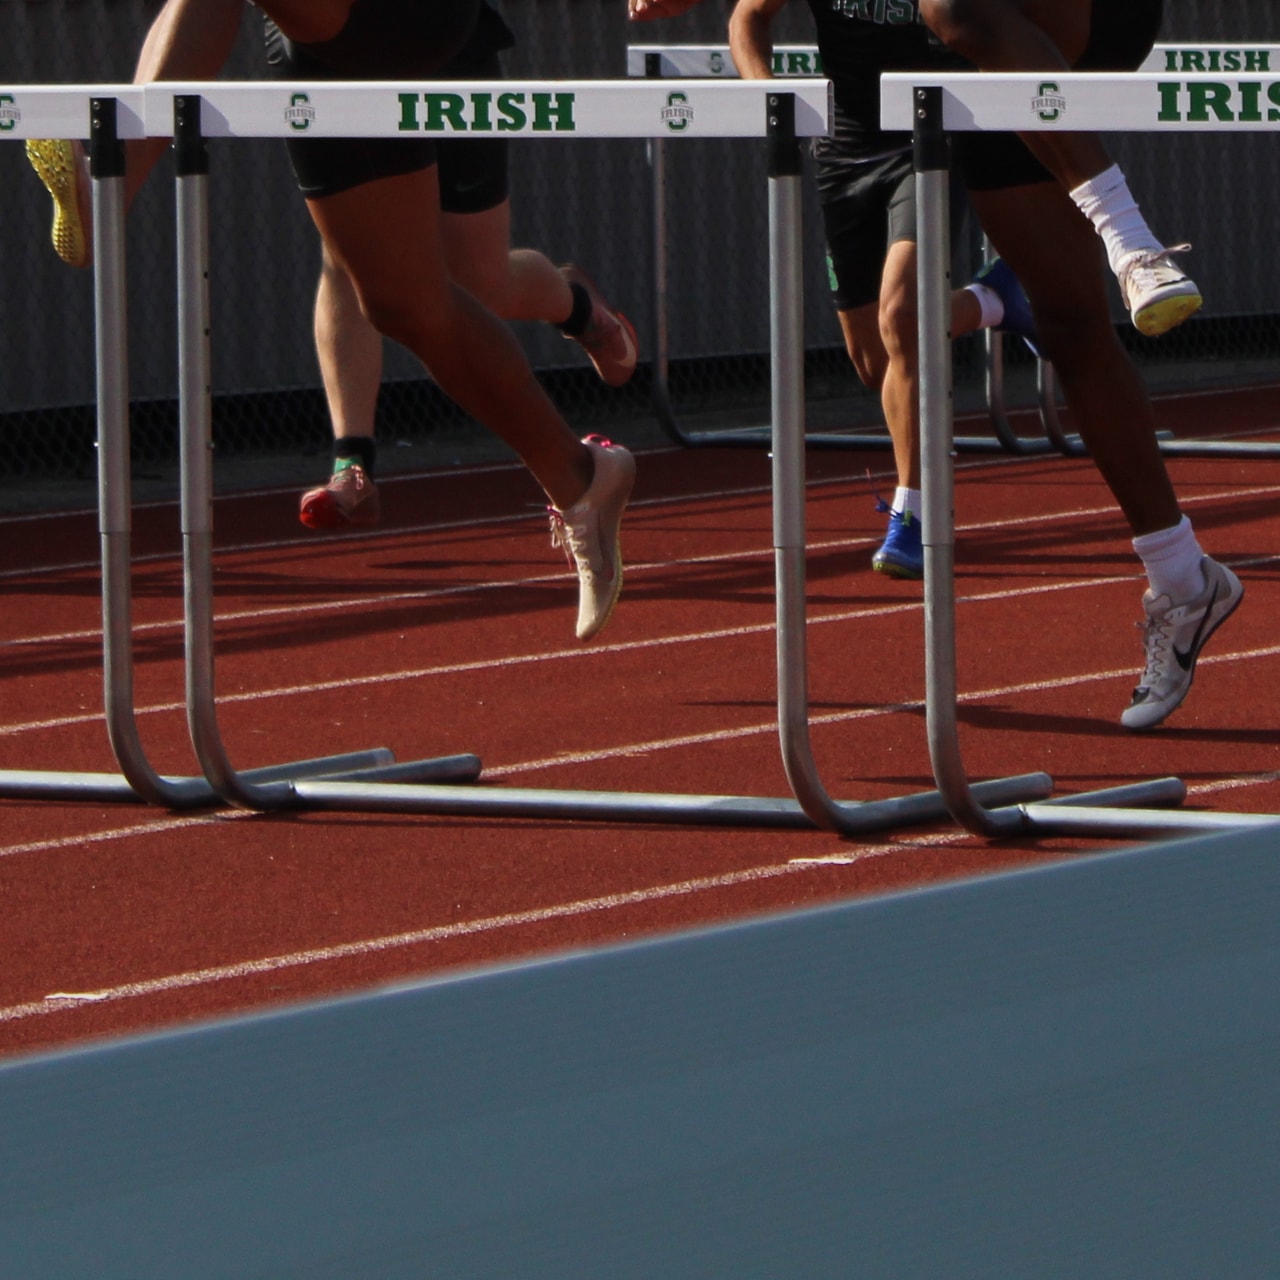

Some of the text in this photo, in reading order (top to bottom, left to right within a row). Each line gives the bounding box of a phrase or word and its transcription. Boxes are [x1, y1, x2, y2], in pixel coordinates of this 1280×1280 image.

[1165, 50, 1269, 71] IRISH
[398, 92, 576, 131] IRISH
[1031, 97, 1066, 111] IRISH
